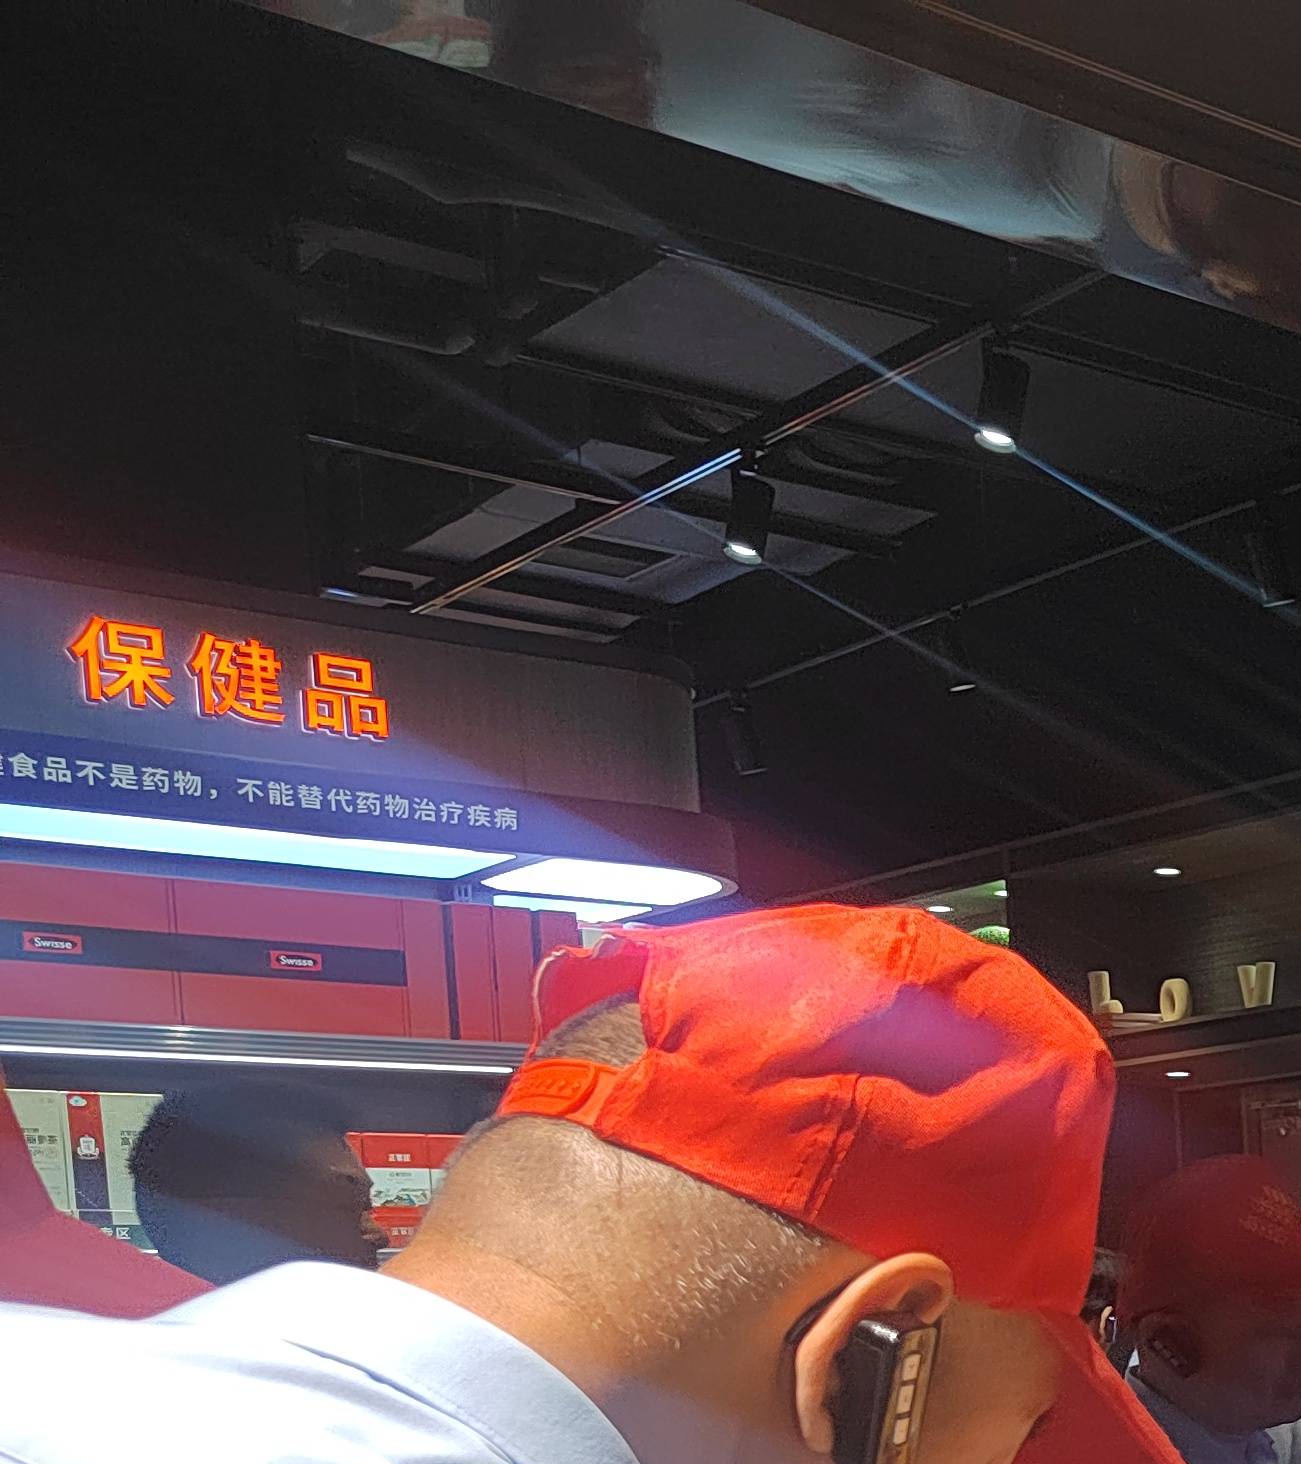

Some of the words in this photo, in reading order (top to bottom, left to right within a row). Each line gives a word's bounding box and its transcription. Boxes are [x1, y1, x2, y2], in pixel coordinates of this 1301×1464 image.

[67, 616, 391, 742] 保健品
[34, 936, 74, 950] Swisse
[279, 954, 314, 967] Swisse
